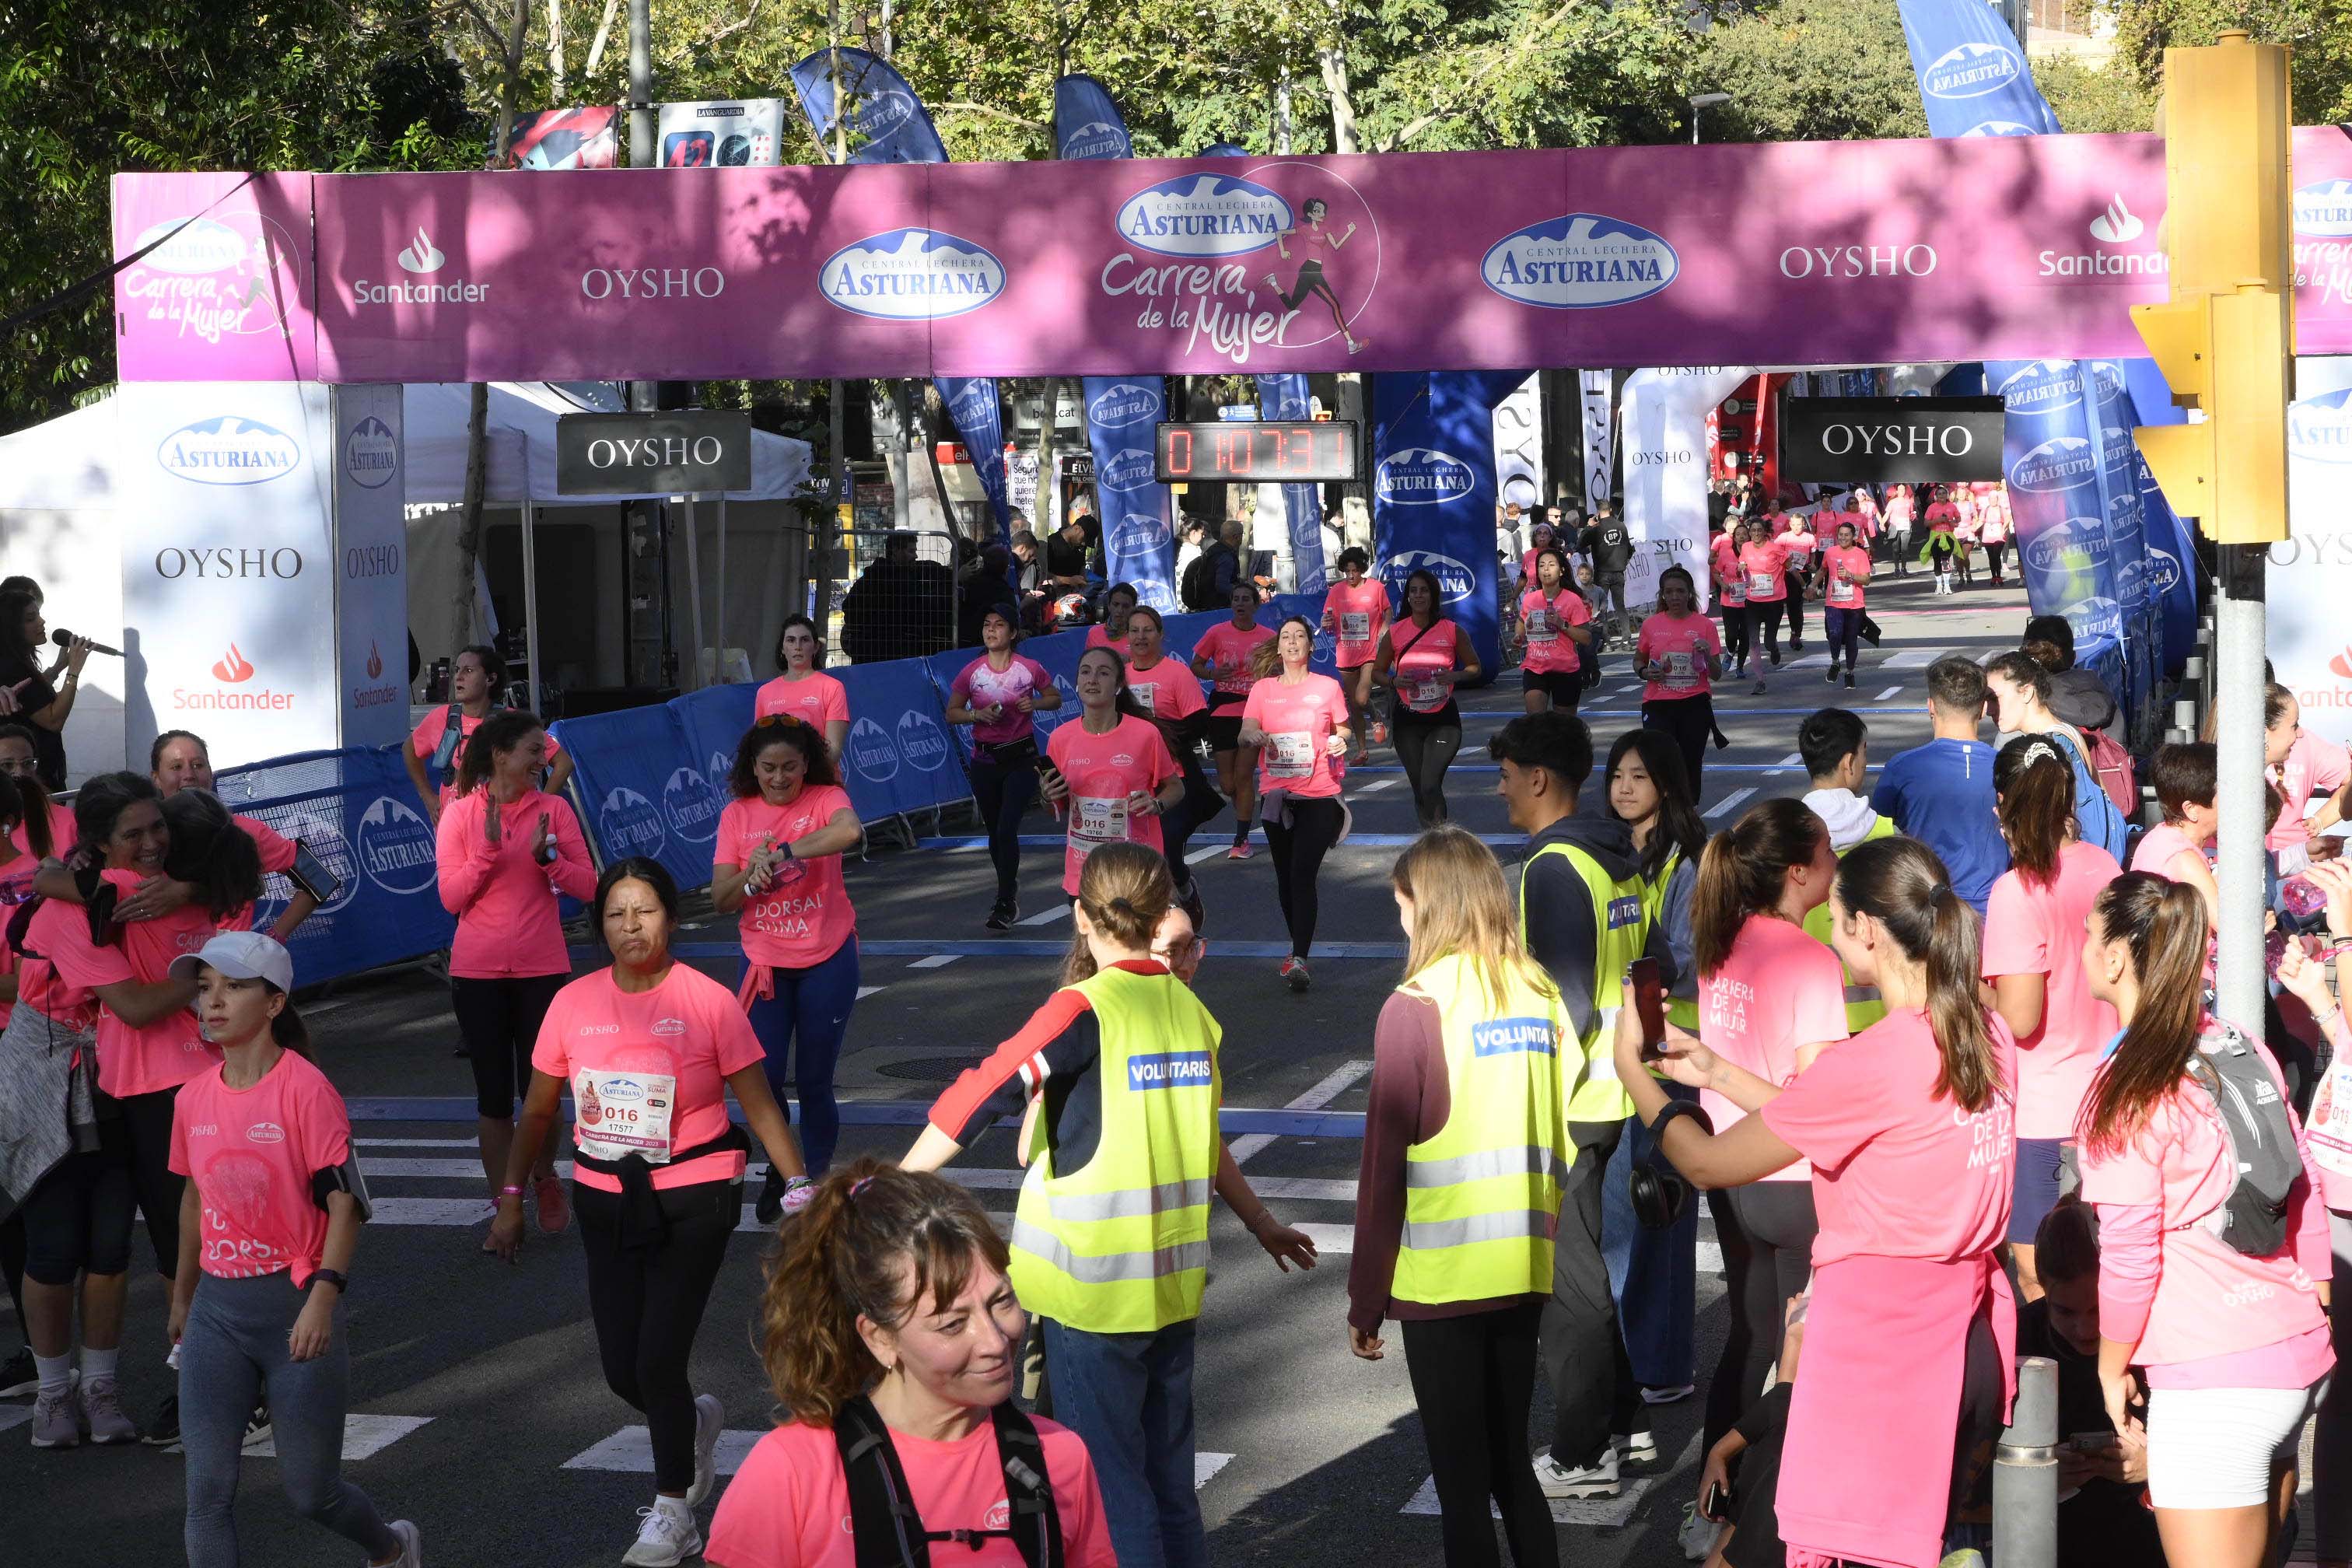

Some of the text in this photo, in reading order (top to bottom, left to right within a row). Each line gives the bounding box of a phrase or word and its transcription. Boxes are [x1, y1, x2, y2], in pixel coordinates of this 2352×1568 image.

[1157, 201, 1275, 212] CENTRAL LECHERA
[1130, 205, 1279, 236] ASTURIANA
[862, 258, 985, 269] CENTRAL LECHERA
[1527, 245, 1657, 257] CENTRAL LECHERA
[1780, 243, 1937, 279] OYSHO
[2039, 250, 2168, 276] Santand
[833, 262, 992, 296] ASTURIANA
[1101, 253, 1248, 297] Carrera
[1496, 250, 1664, 285] ASTURIANA
[124, 269, 218, 299] Carrera
[354, 279, 489, 304] Santander
[582, 267, 725, 299] OYSHO
[179, 295, 253, 344] Mujer
[1137, 292, 1301, 364] de la Mujer
[587, 436, 723, 468] OYSHO
[1822, 424, 1973, 457] OYSHO
[169, 442, 289, 467] ASTURIANA
[351, 450, 394, 471] ASTURIANA
[1633, 450, 1692, 467] OYSHO
[1379, 470, 1468, 492] ASTURIANA
[155, 548, 303, 579] OYSHO
[347, 544, 399, 579] OYSHO
[173, 688, 295, 710] Santander
[353, 684, 397, 709] Santander
[1084, 819, 1105, 828] 016
[366, 837, 436, 874] ASTURIANA
[755, 892, 824, 919] DORSAL
[756, 918, 809, 933] SUMA
[1712, 992, 1729, 1011] DE
[580, 1024, 620, 1037] OYSHO
[603, 1086, 641, 1097] ASTURIANA
[605, 1107, 638, 1122] 016
[585, 1131, 609, 1140] CARRERA
[608, 1123, 634, 1134] 17577
[1974, 1118, 1993, 1146] DE
